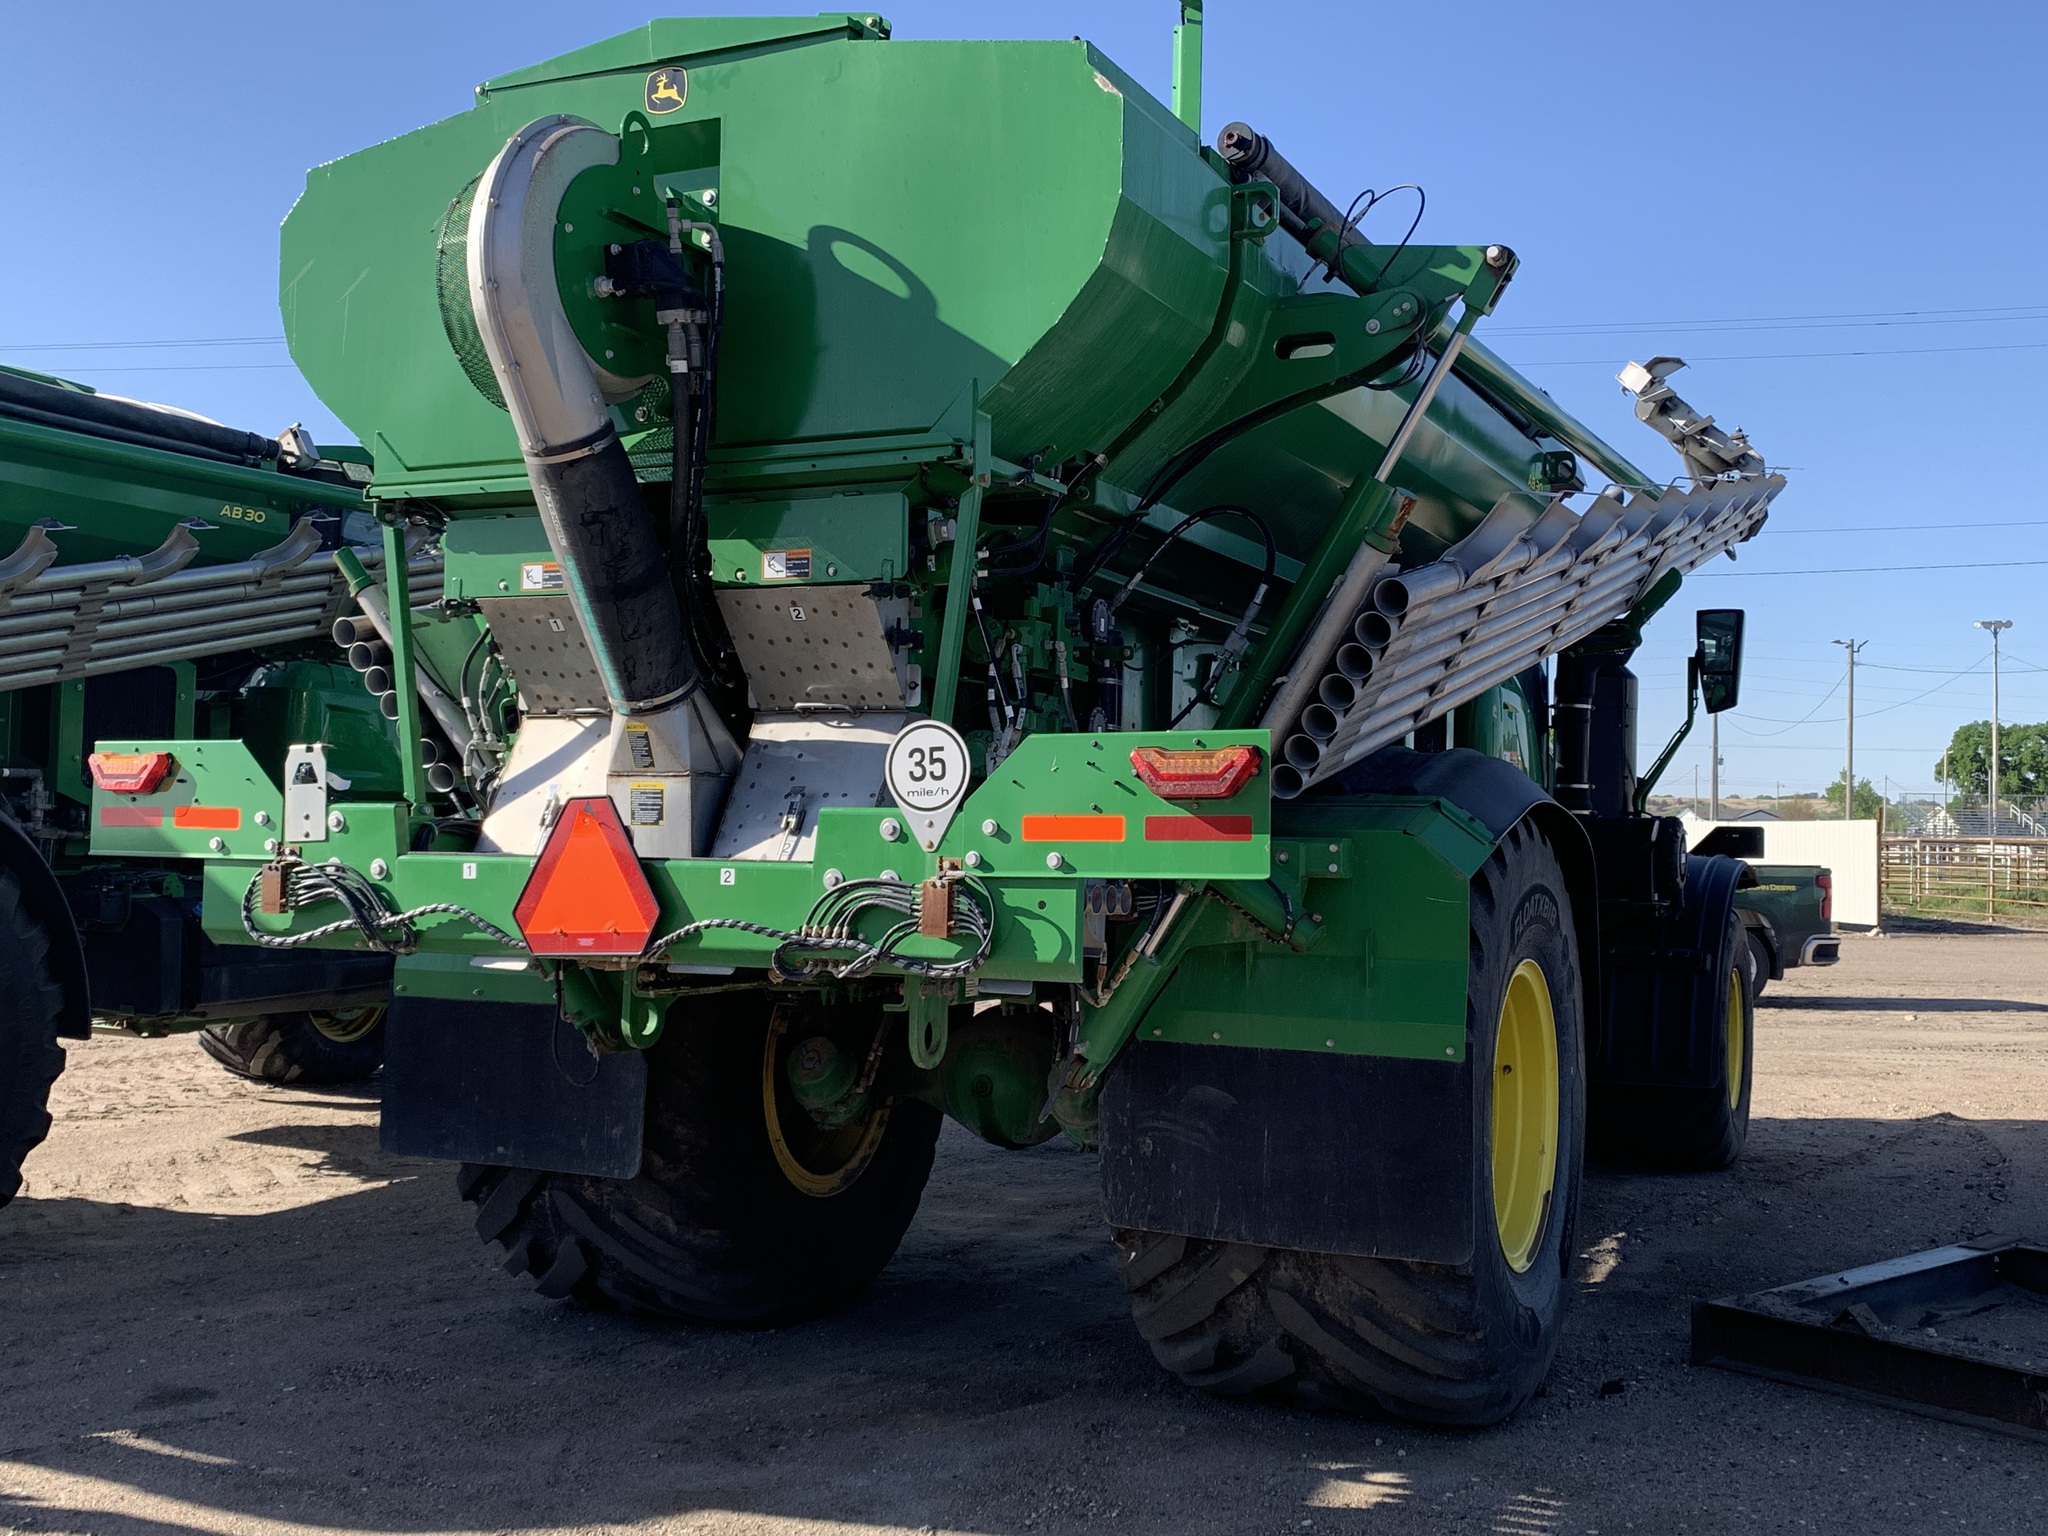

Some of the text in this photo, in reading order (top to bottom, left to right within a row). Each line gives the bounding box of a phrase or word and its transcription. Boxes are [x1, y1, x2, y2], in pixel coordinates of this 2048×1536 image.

[546, 500, 566, 543] TEXCEL
[793, 608, 803, 619] 2
[908, 746, 947, 782] 35
[907, 787, 950, 797] mile/h
[782, 842, 791, 853] 2
[723, 870, 732, 883] 2
[1514, 893, 1557, 946] FLOATXBIB
